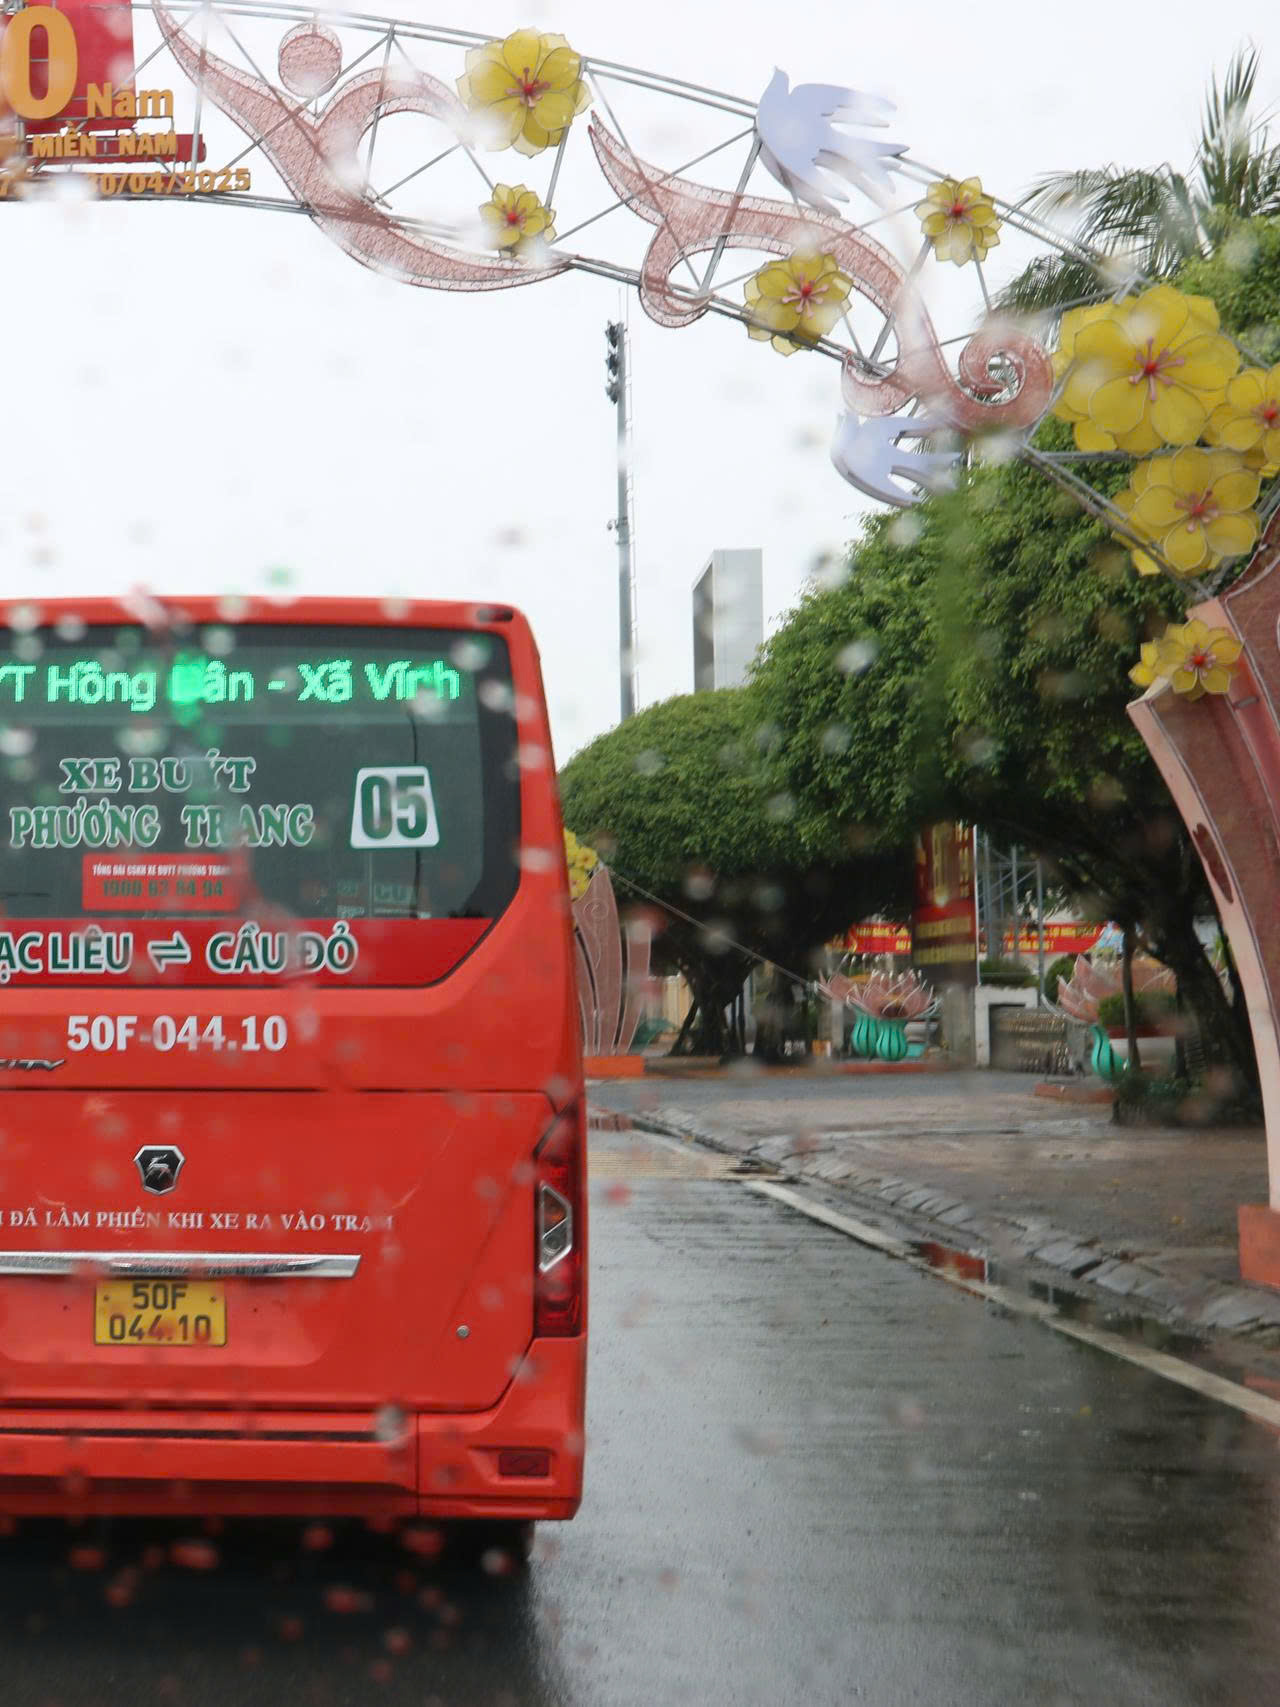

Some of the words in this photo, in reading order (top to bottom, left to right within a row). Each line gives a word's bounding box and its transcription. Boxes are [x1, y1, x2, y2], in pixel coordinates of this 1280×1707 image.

[32, 121, 97, 157] MIỀN
[119, 131, 177, 156] NAM
[47, 661, 157, 712] Hồng
[170, 660, 254, 702] ân
[297, 660, 353, 702] Xã
[59, 757, 121, 793] XE
[9, 796, 161, 848] PHƯƠNG
[361, 774, 428, 839] 05
[49, 924, 134, 974] LIÊU
[67, 1015, 287, 1052] 50F-044.10
[10, 1206, 38, 1227] ĐÃ
[45, 1206, 91, 1228] LÀM
[168, 1211, 204, 1230] KHI
[209, 1212, 240, 1230] XE
[245, 1212, 272, 1231] RA
[280, 1209, 326, 1231] VÀO
[131, 1281, 188, 1311] 50F
[109, 1313, 212, 1341] 044.10
